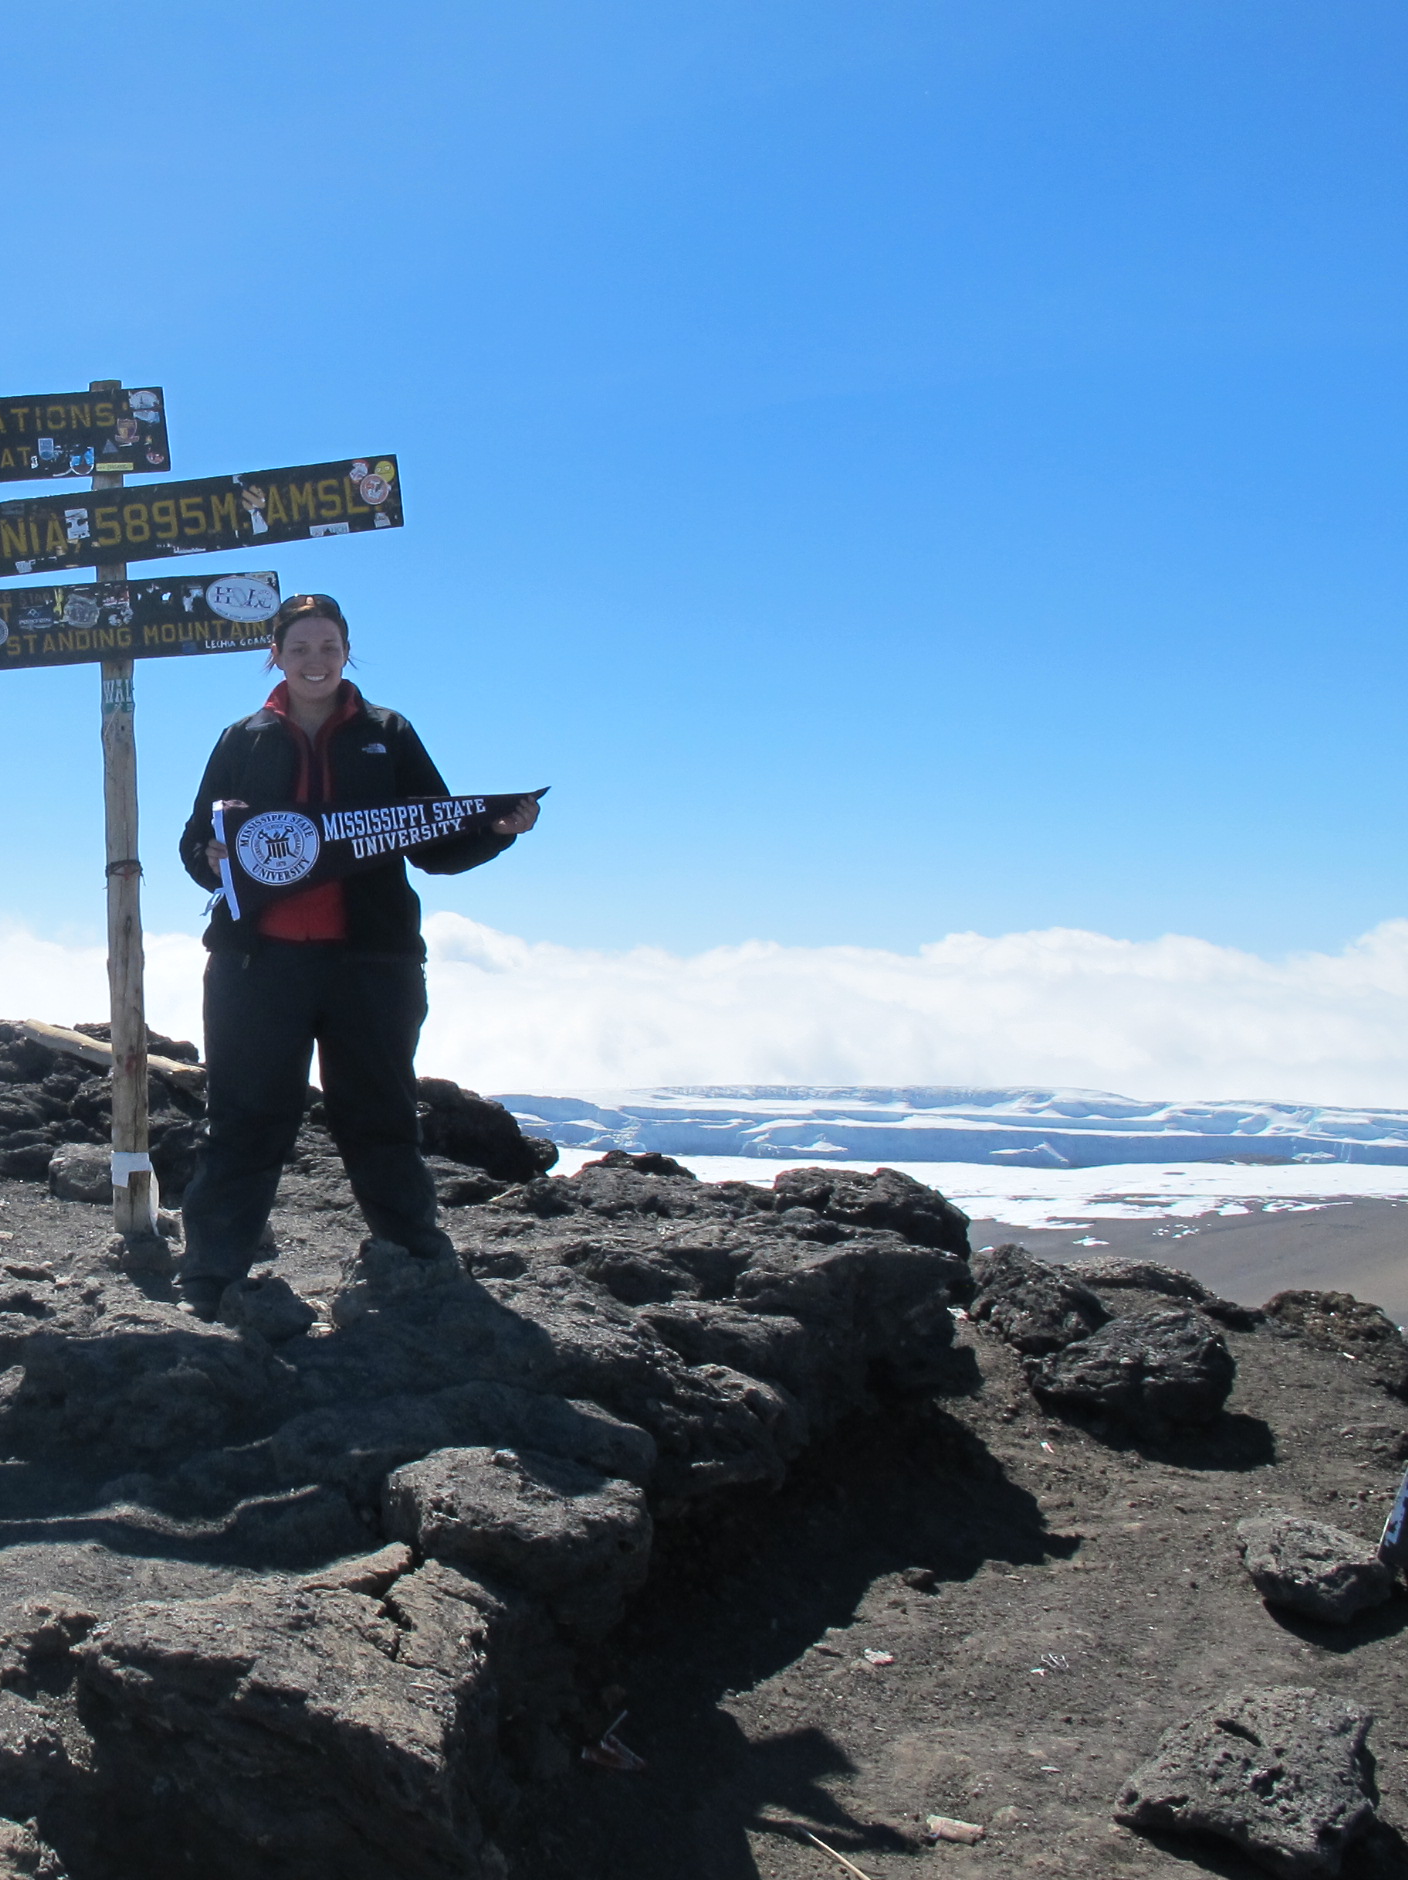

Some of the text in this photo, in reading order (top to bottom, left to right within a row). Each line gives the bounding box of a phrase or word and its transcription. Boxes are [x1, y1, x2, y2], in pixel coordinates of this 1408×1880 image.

[0, 446, 32, 468] AT
[144, 620, 267, 645] MOUNTAIN
[239, 814, 289, 848] MISSISSIPPI
[290, 815, 315, 839] STATE
[321, 798, 486, 841] MISSISSIPPI STATE
[351, 817, 463, 859] UNIVERSITY
[252, 856, 310, 881] UNIVERSITY
